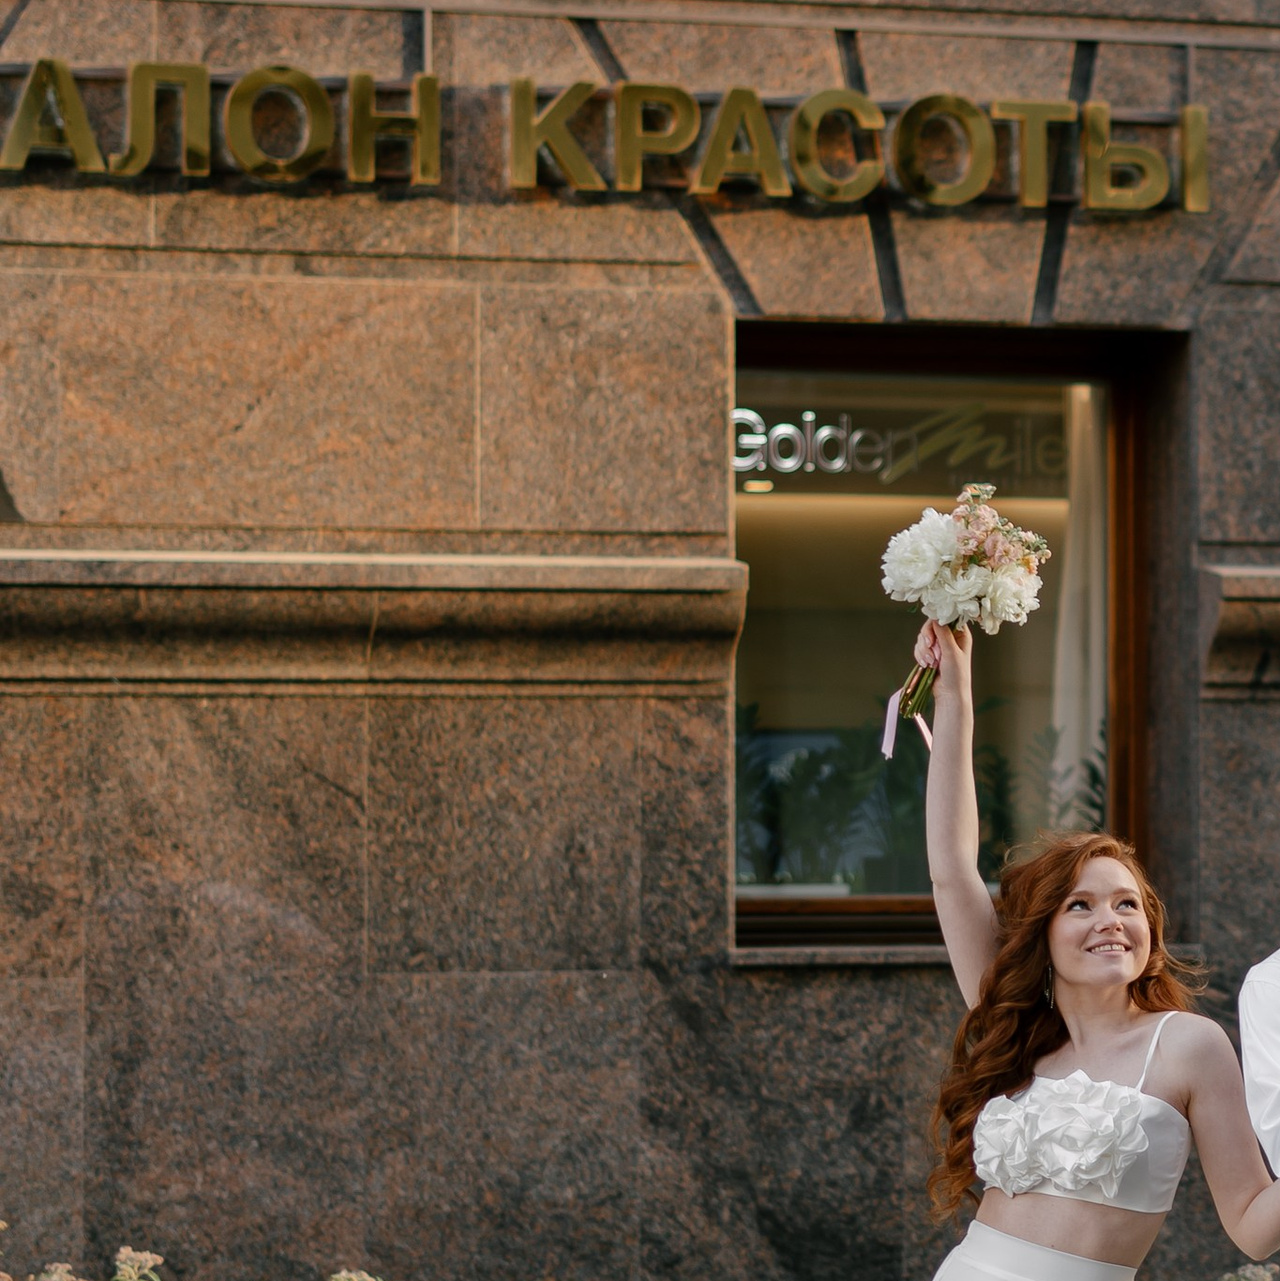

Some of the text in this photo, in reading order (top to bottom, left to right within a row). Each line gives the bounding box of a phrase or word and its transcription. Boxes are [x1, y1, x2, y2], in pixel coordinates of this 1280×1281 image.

[0, 58, 1211, 214] АЛОН КРАСОТЫ
[730, 407, 919, 474] Golden
